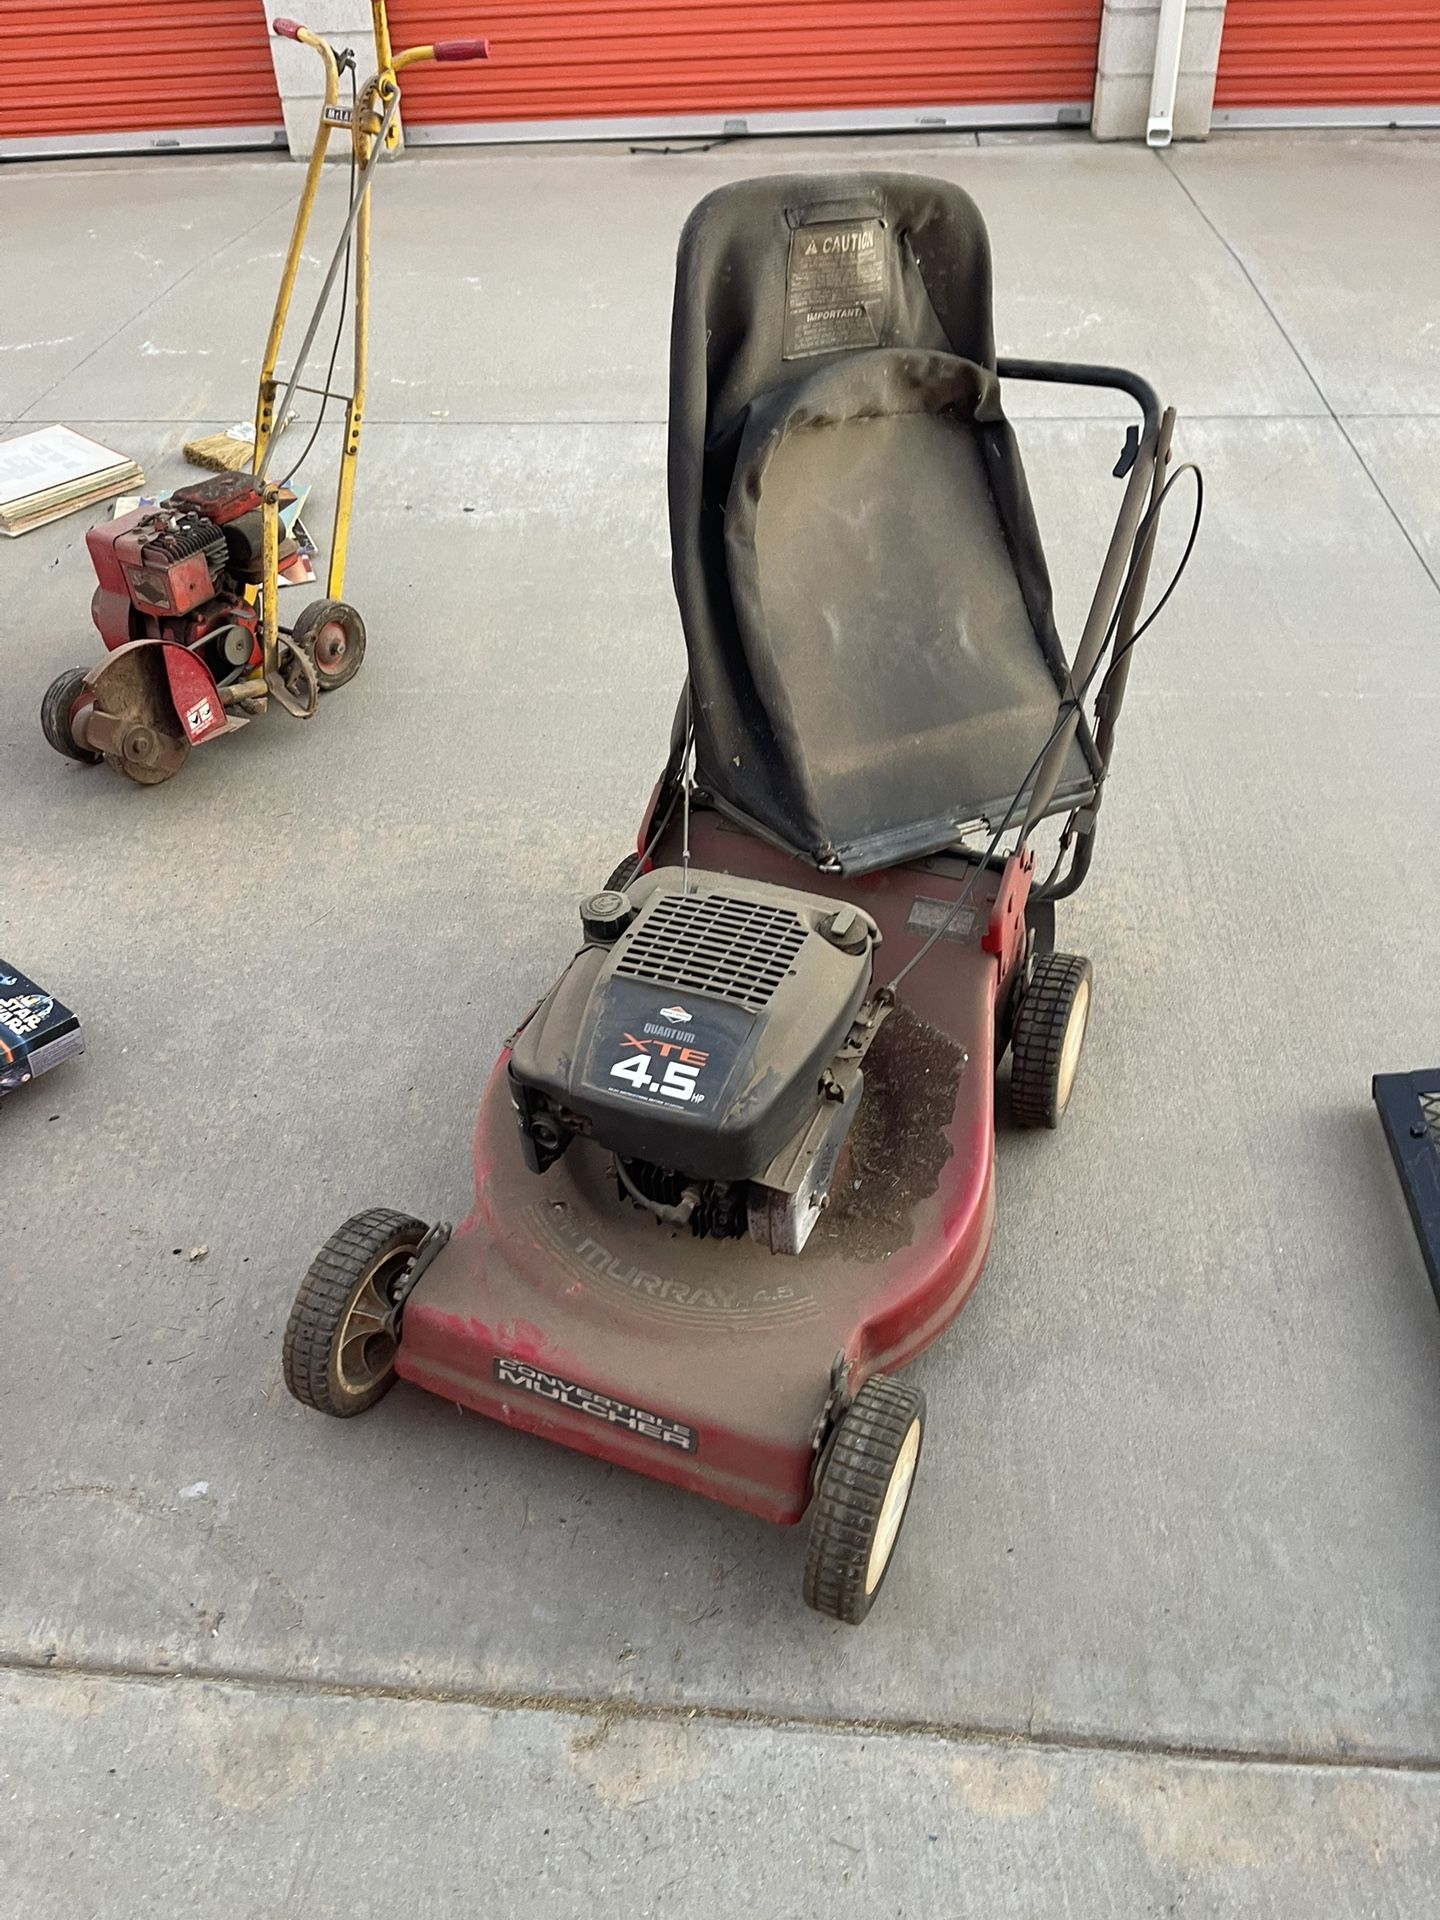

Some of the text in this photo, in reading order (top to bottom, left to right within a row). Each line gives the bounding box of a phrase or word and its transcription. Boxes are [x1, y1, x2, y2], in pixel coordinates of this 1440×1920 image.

[823, 230, 874, 254] CAUTION
[0, 997, 42, 1030] STAR
[643, 1022, 696, 1044] QUANTUM
[619, 1032, 710, 1067] XTE
[610, 1053, 700, 1101] 4.5
[691, 1092, 705, 1104] HP
[575, 1237, 740, 1308] MURRAY
[499, 1367, 690, 1449] MULCHER
[500, 1358, 691, 1437] CONVERTIBLE
